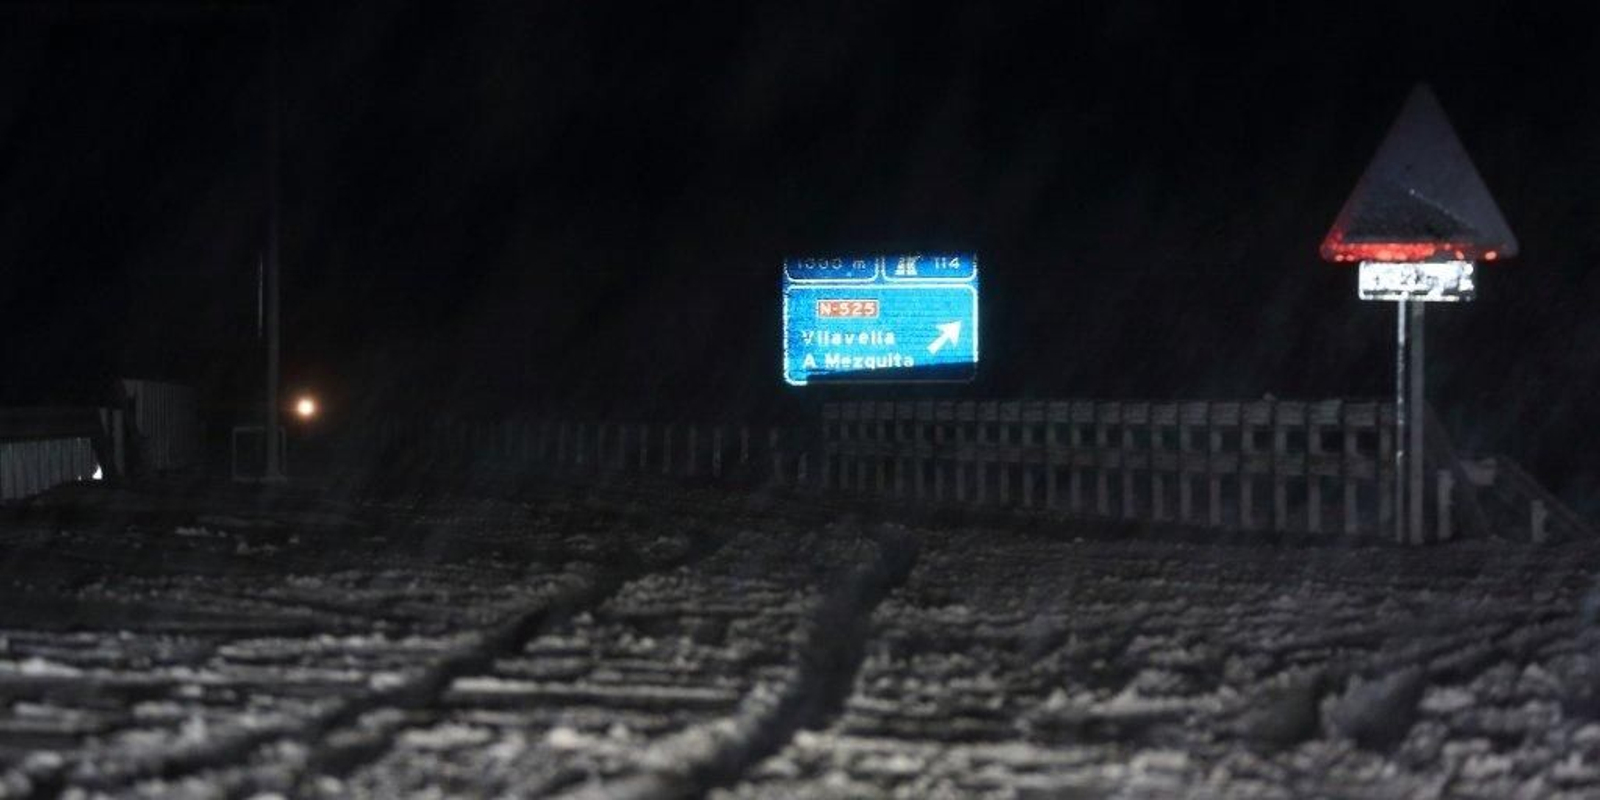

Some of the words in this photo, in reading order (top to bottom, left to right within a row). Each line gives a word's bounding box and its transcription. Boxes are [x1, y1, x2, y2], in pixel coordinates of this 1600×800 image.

[935, 257, 960, 269] 114
[819, 302, 876, 315] N-525
[803, 354, 816, 368] A
[825, 353, 915, 370] Mezquita
